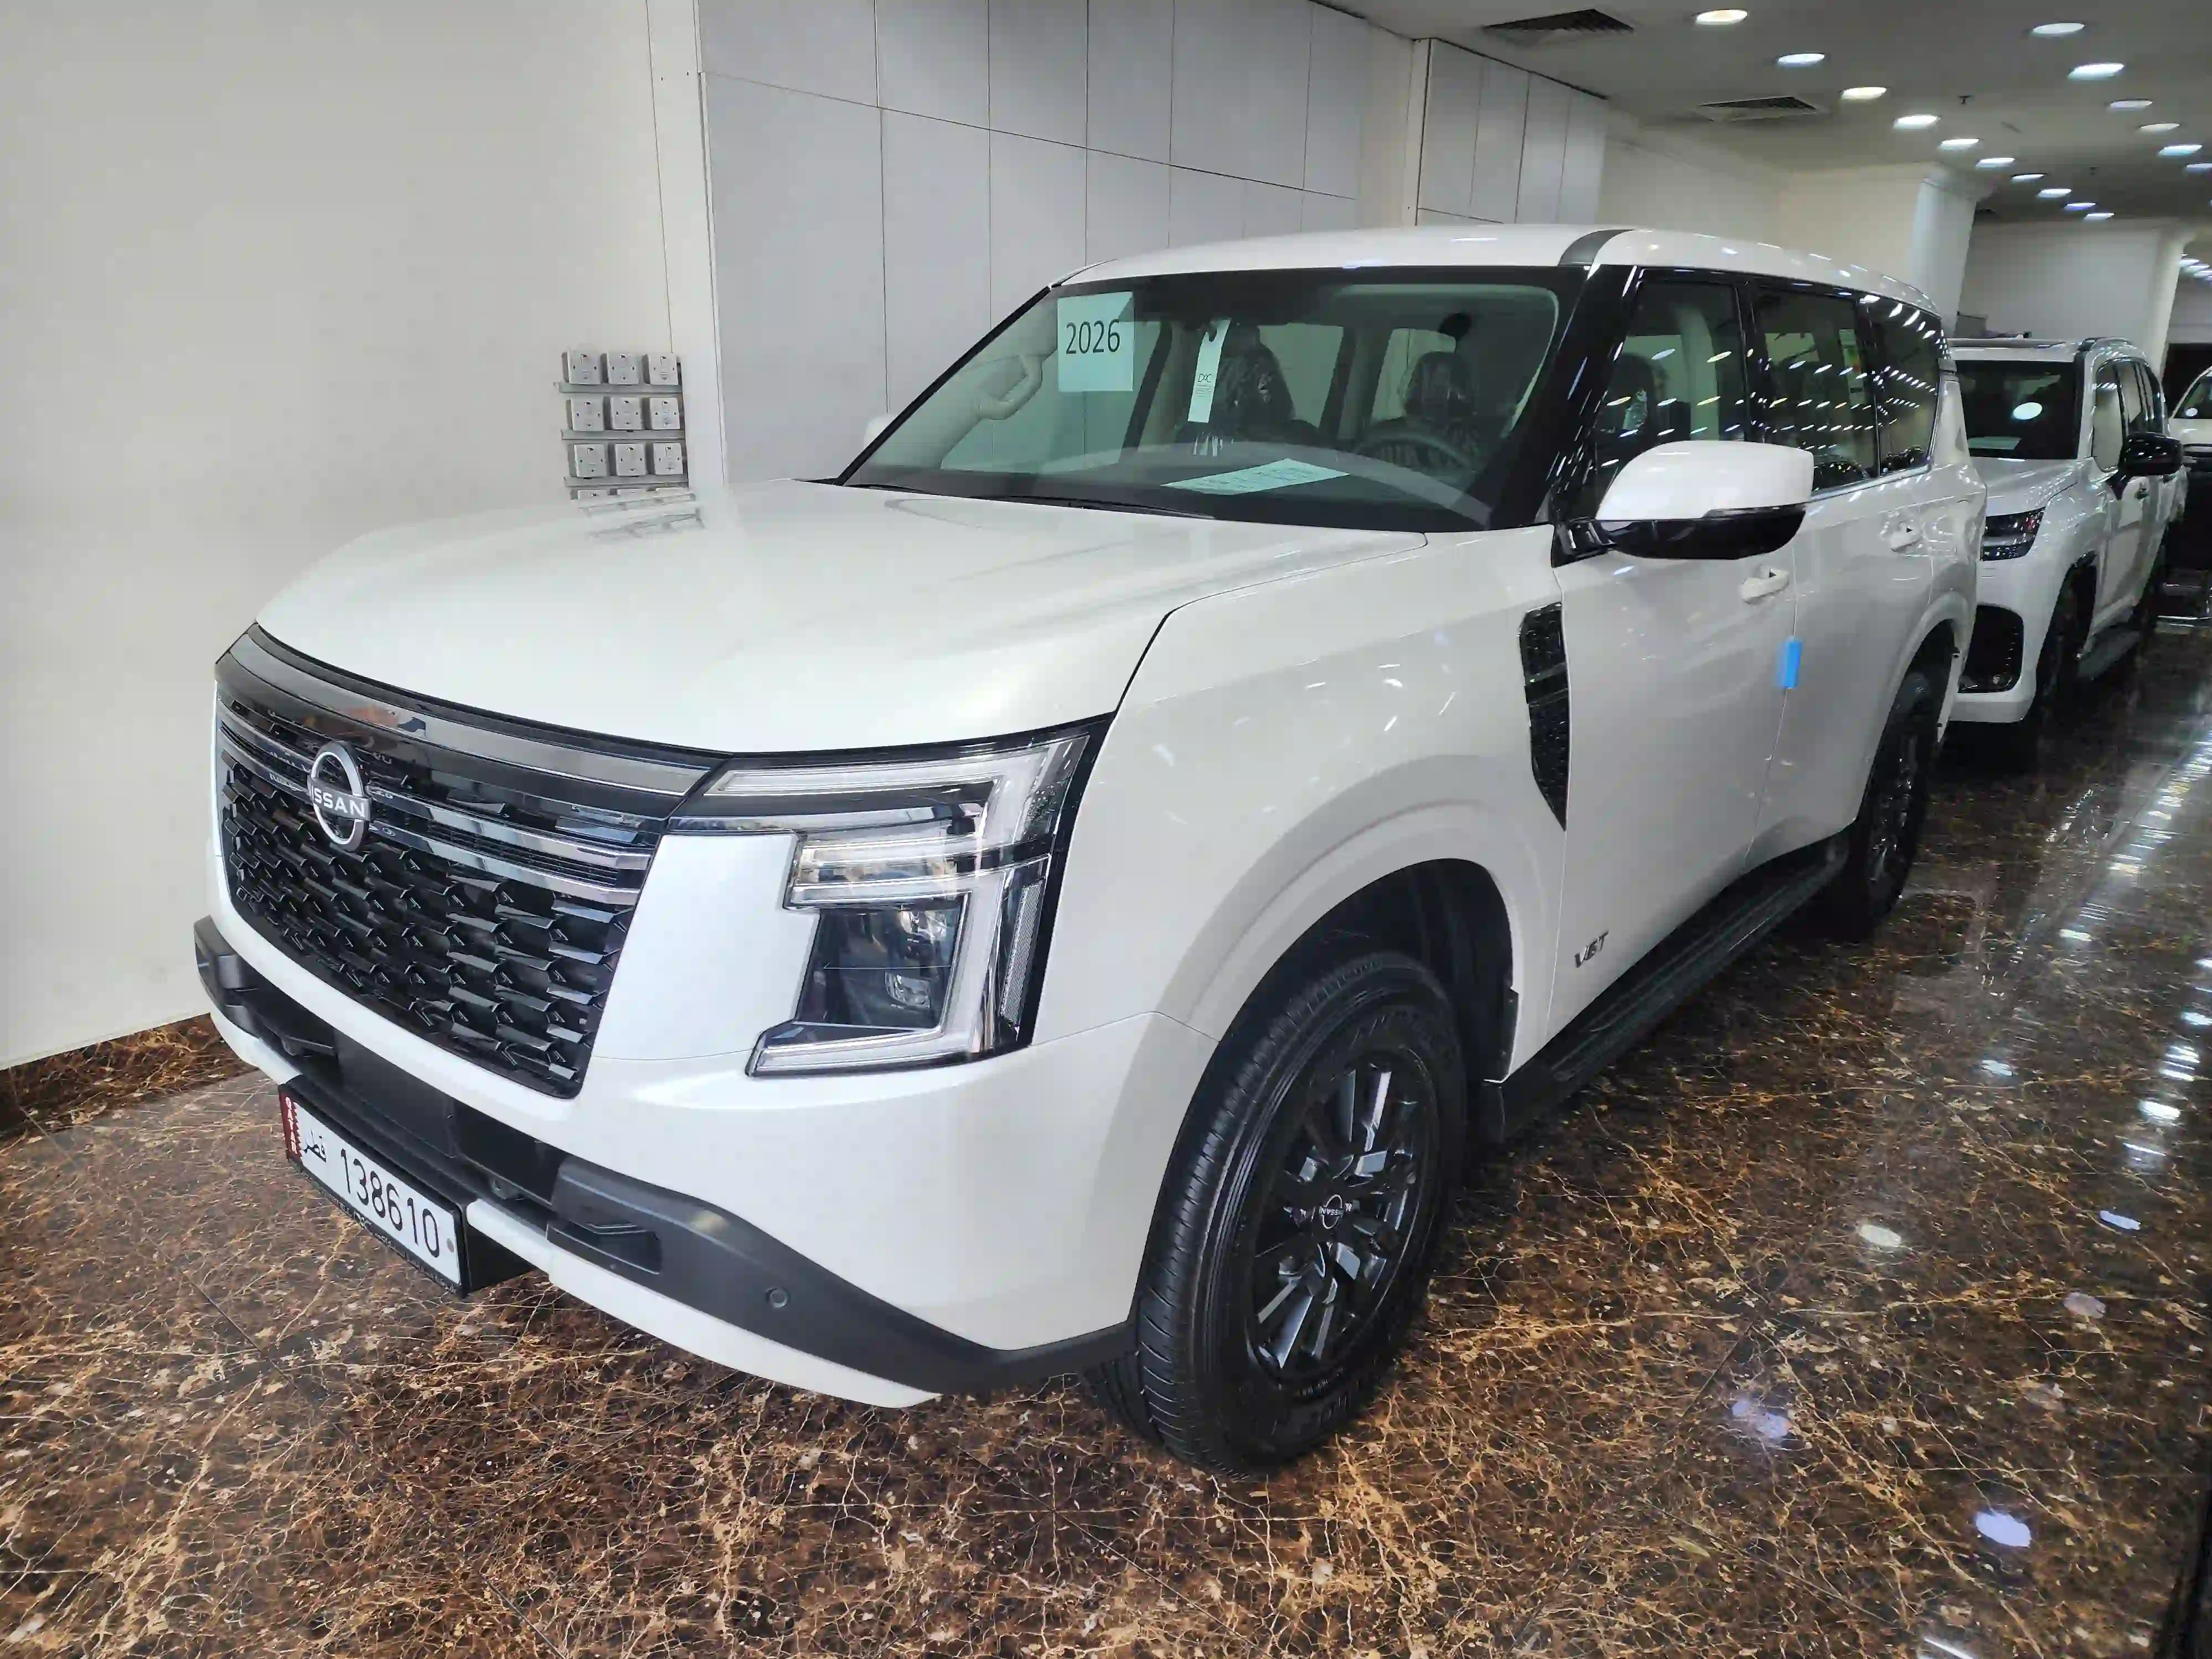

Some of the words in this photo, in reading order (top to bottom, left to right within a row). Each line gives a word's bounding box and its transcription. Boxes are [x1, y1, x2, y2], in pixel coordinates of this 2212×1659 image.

[1065, 319, 1120, 355] 2026
[285, 1097, 298, 1154] QATAR
[303, 1128, 327, 1163] قطر
[340, 1148, 440, 1258] 138610
